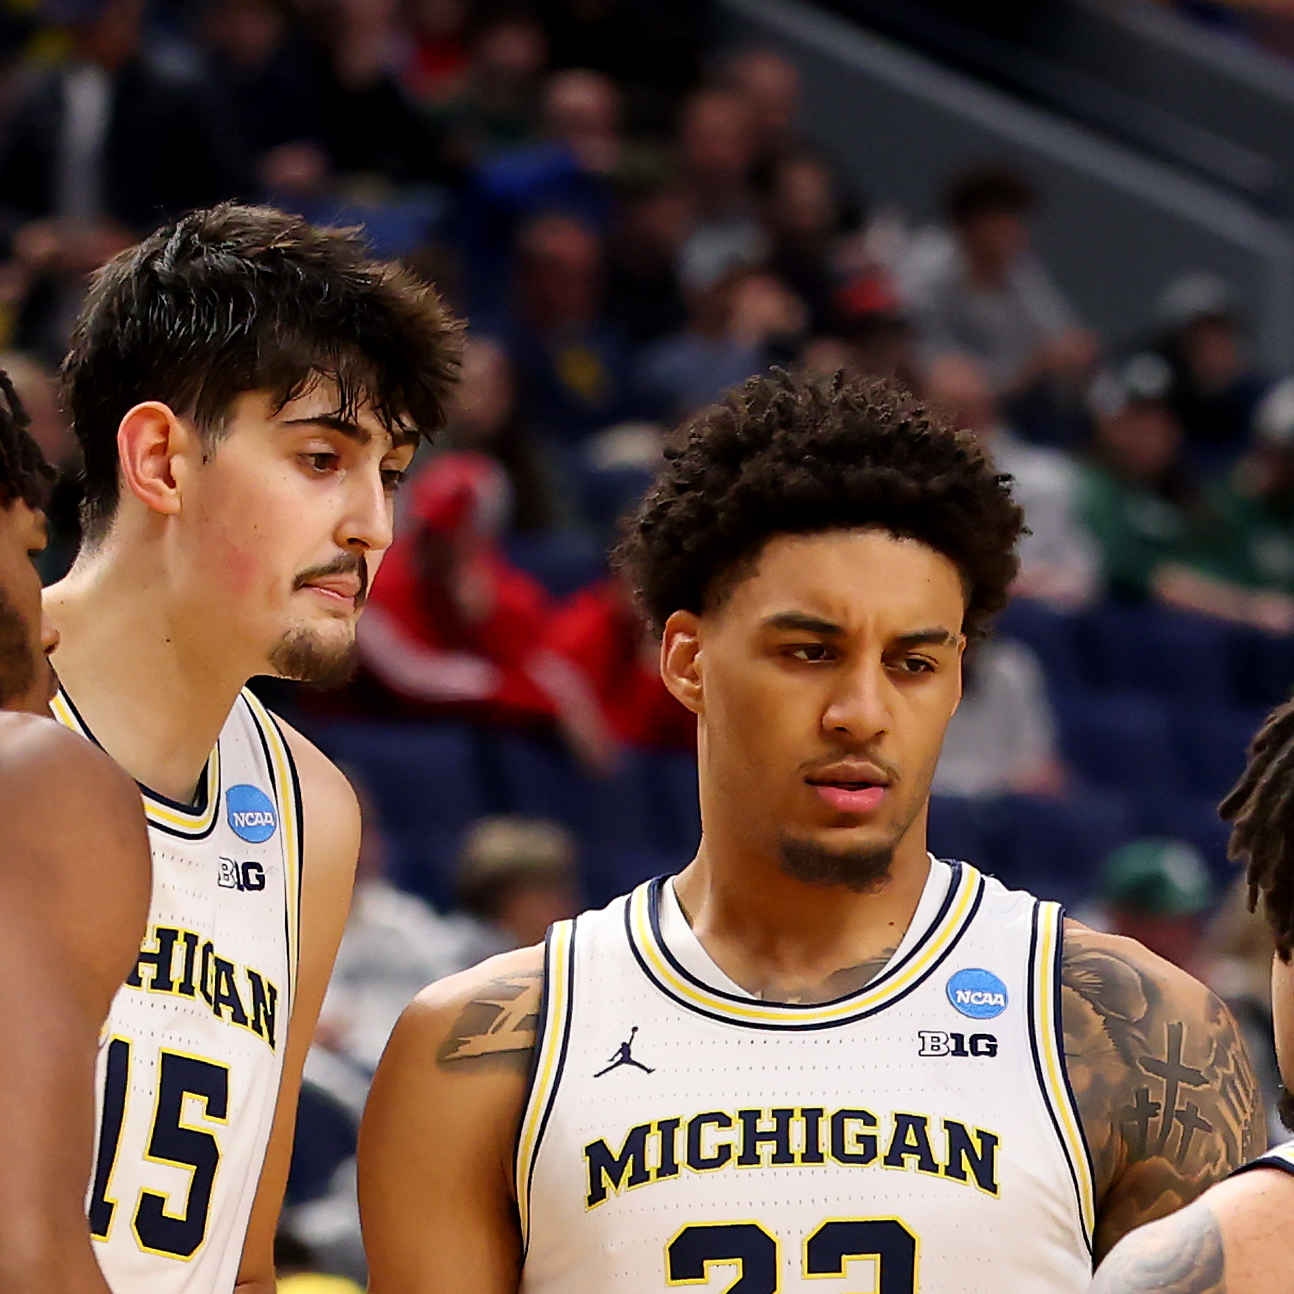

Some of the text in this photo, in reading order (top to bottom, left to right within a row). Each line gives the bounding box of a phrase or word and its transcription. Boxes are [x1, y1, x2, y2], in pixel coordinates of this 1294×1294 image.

[232, 812, 275, 828] NCAA
[955, 990, 1006, 1007] NCAA
[89, 1032, 232, 1262] 15
[583, 1106, 1002, 1213] MICHIGAN
